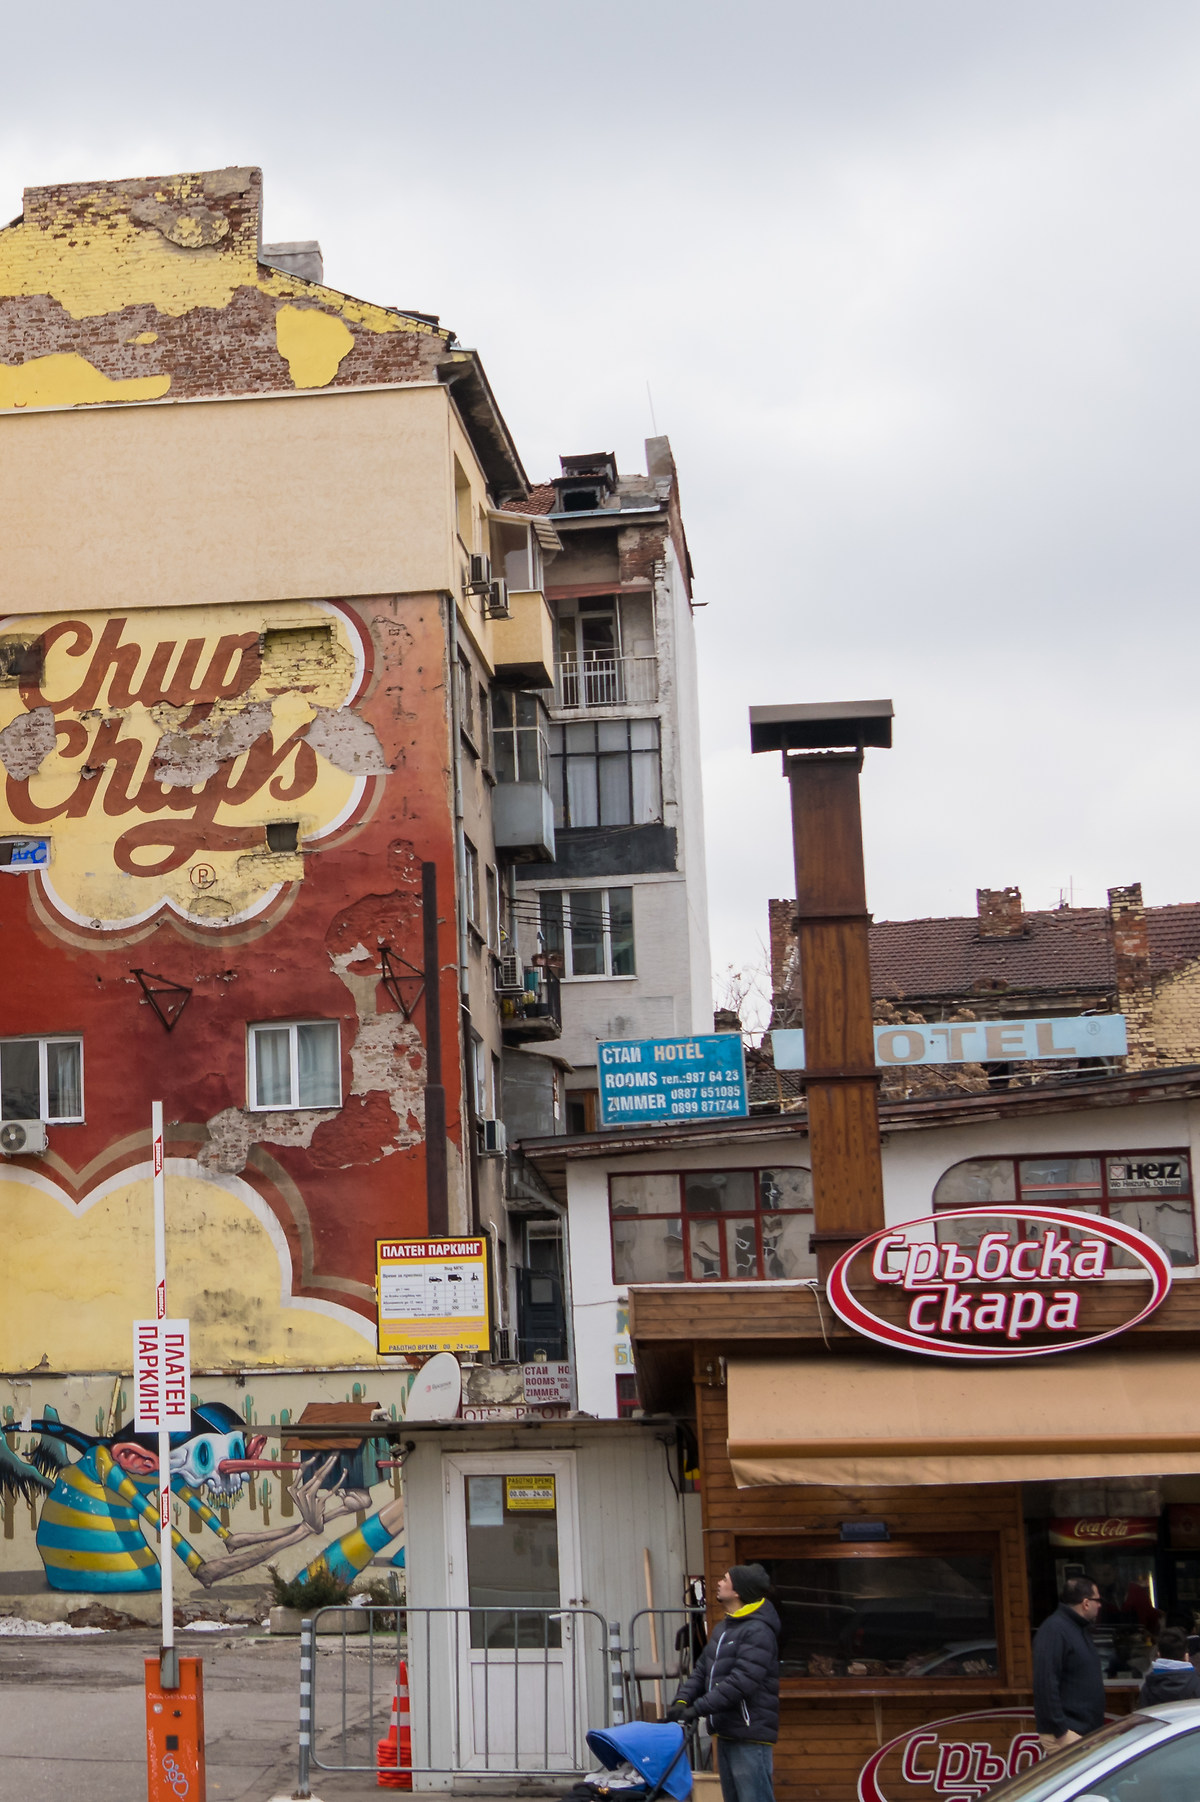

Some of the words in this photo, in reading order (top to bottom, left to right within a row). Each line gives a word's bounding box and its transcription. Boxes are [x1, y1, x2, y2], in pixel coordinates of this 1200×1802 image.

[654, 1042, 704, 1061] HOTEL
[876, 1022, 1076, 1063] OTEL
[605, 1072, 657, 1088] ROOMS
[709, 1071, 723, 1082] 64
[725, 1070, 739, 1081] 23
[671, 1088, 697, 1100] 0887
[701, 1085, 740, 1098] 651085
[607, 1094, 666, 1112] ZIMMER
[671, 1102, 698, 1114] 0899
[701, 1099, 740, 1112] 871744
[382, 1245, 426, 1257] ПЛАТЕН
[428, 1243, 480, 1256] ПАРКИНГ
[872, 1231, 1106, 1290] Сръбска
[909, 1284, 1080, 1340] скара
[138, 1326, 160, 1425] ПАРКИНГ
[164, 1334, 186, 1415] ПЛАТЕН
[525, 1378, 555, 1386] ROOMS
